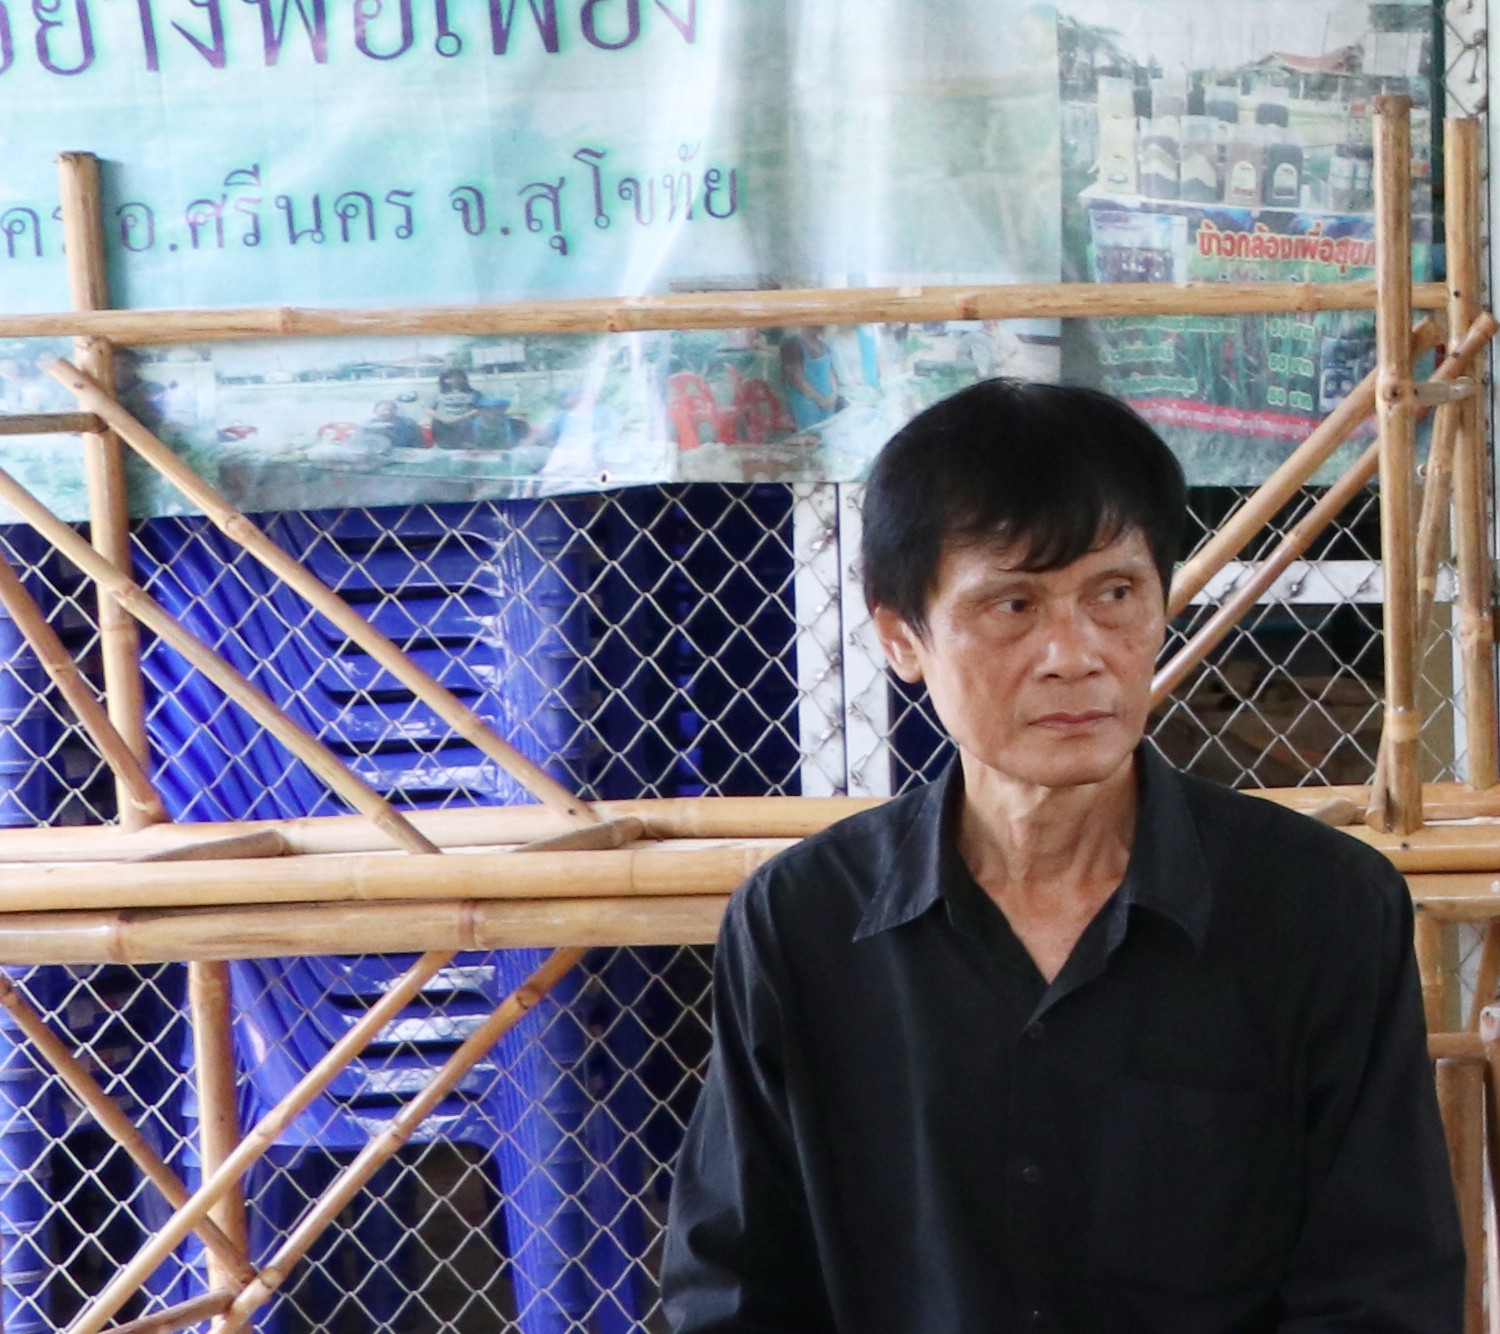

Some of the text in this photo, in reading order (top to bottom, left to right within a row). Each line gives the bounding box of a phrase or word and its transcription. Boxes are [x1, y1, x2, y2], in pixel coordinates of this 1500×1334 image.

[116, 163, 416, 253] อ.ศรีนคร
[449, 141, 740, 256] จ.สุโขทัย
